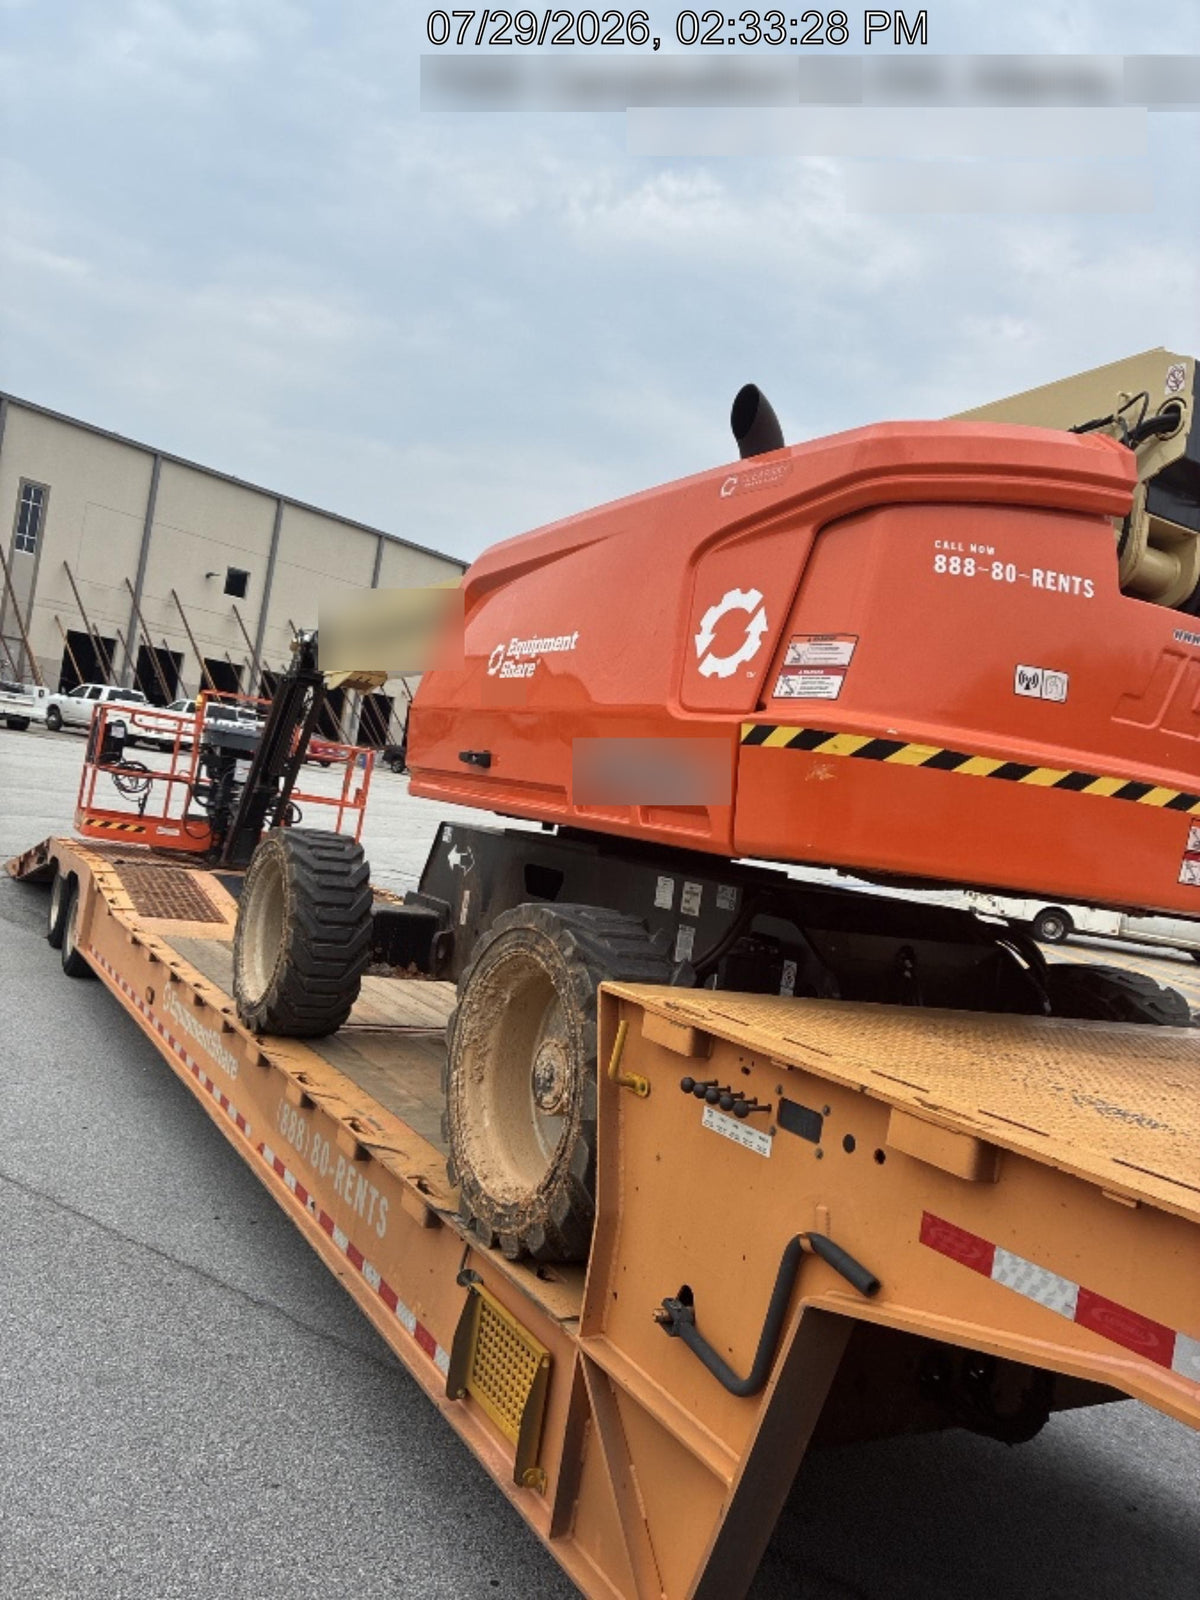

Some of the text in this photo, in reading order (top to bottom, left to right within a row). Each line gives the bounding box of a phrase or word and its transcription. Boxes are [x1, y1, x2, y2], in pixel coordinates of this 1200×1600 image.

[934, 540, 995, 555] CALL NOW
[934, 554, 1095, 598] 888-80-RENTS
[506, 630, 579, 660] Equipment
[499, 660, 536, 678] Share
[276, 1097, 389, 1239] (888) 80-RENTS
